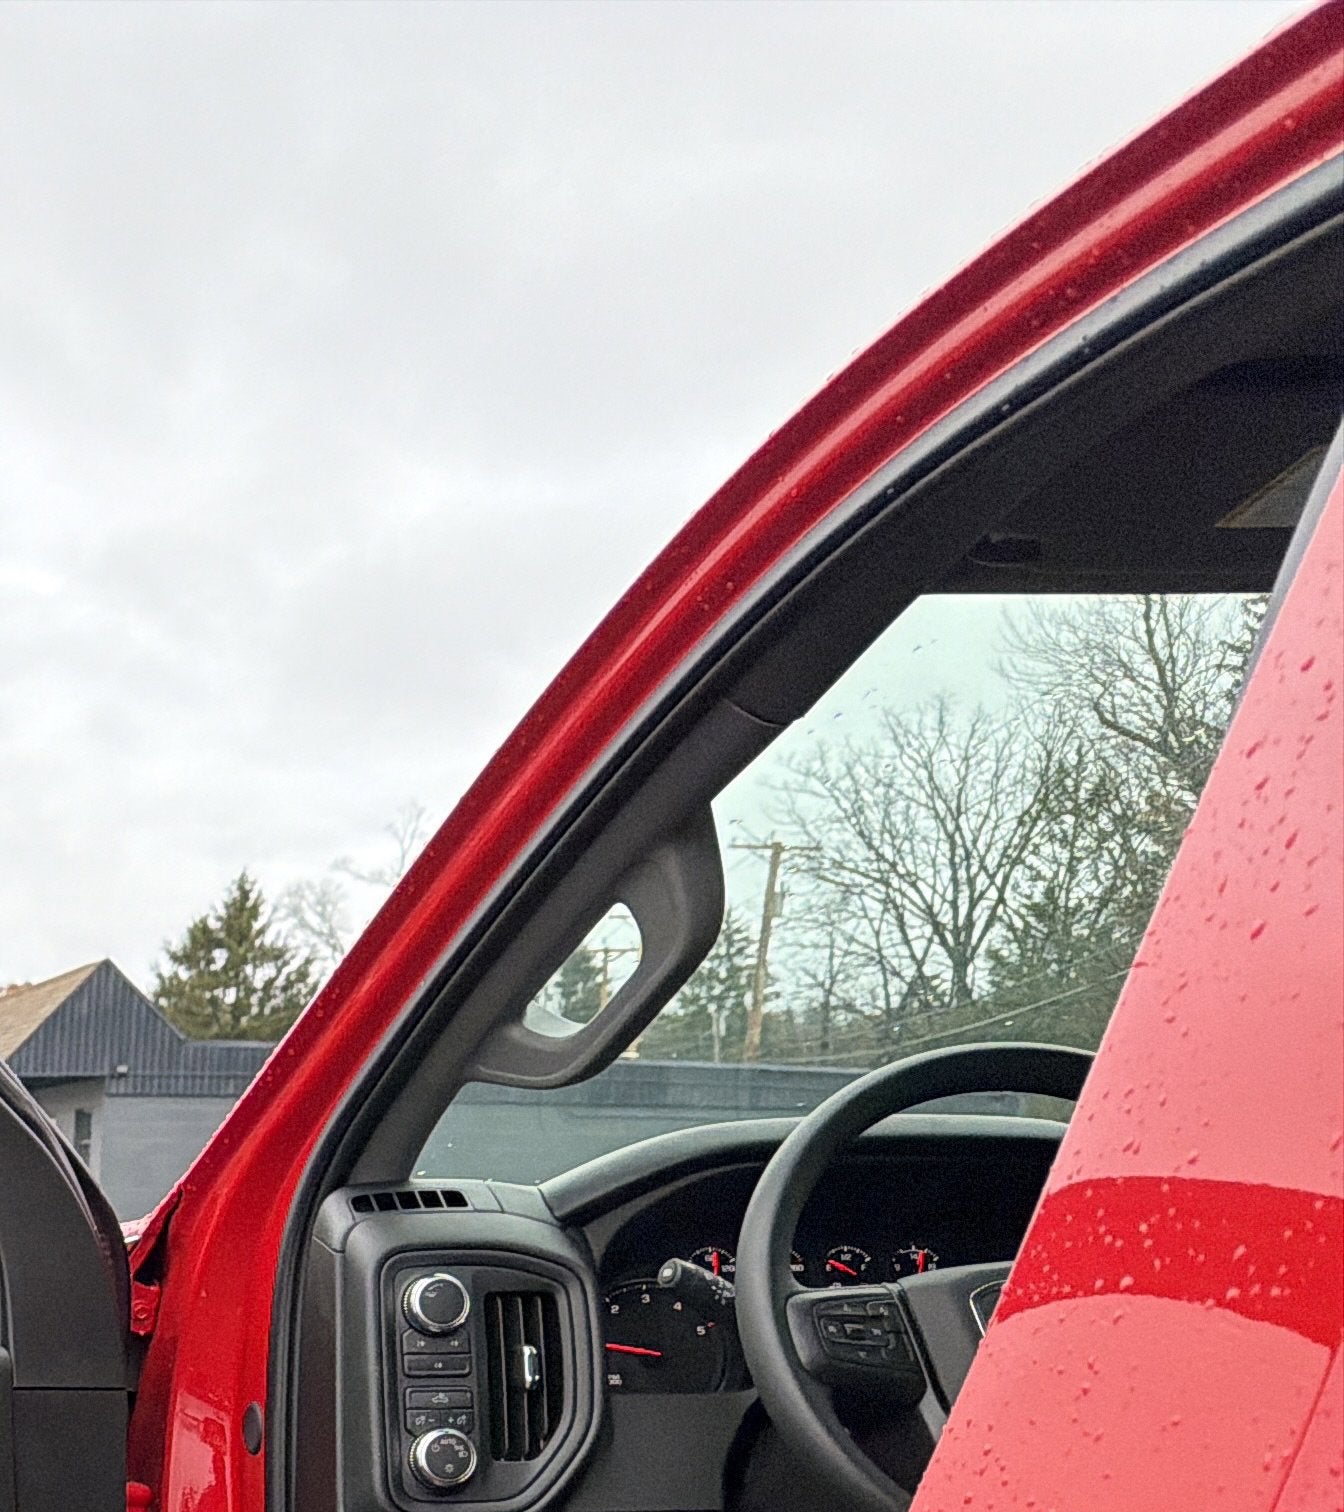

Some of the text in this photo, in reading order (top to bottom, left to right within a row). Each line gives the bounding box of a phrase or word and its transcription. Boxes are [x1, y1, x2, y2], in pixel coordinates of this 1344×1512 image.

[641, 1294, 650, 1303] 3
[610, 1305, 620, 1313] 2
[673, 1302, 682, 1311] 4
[696, 1326, 705, 1335] 5
